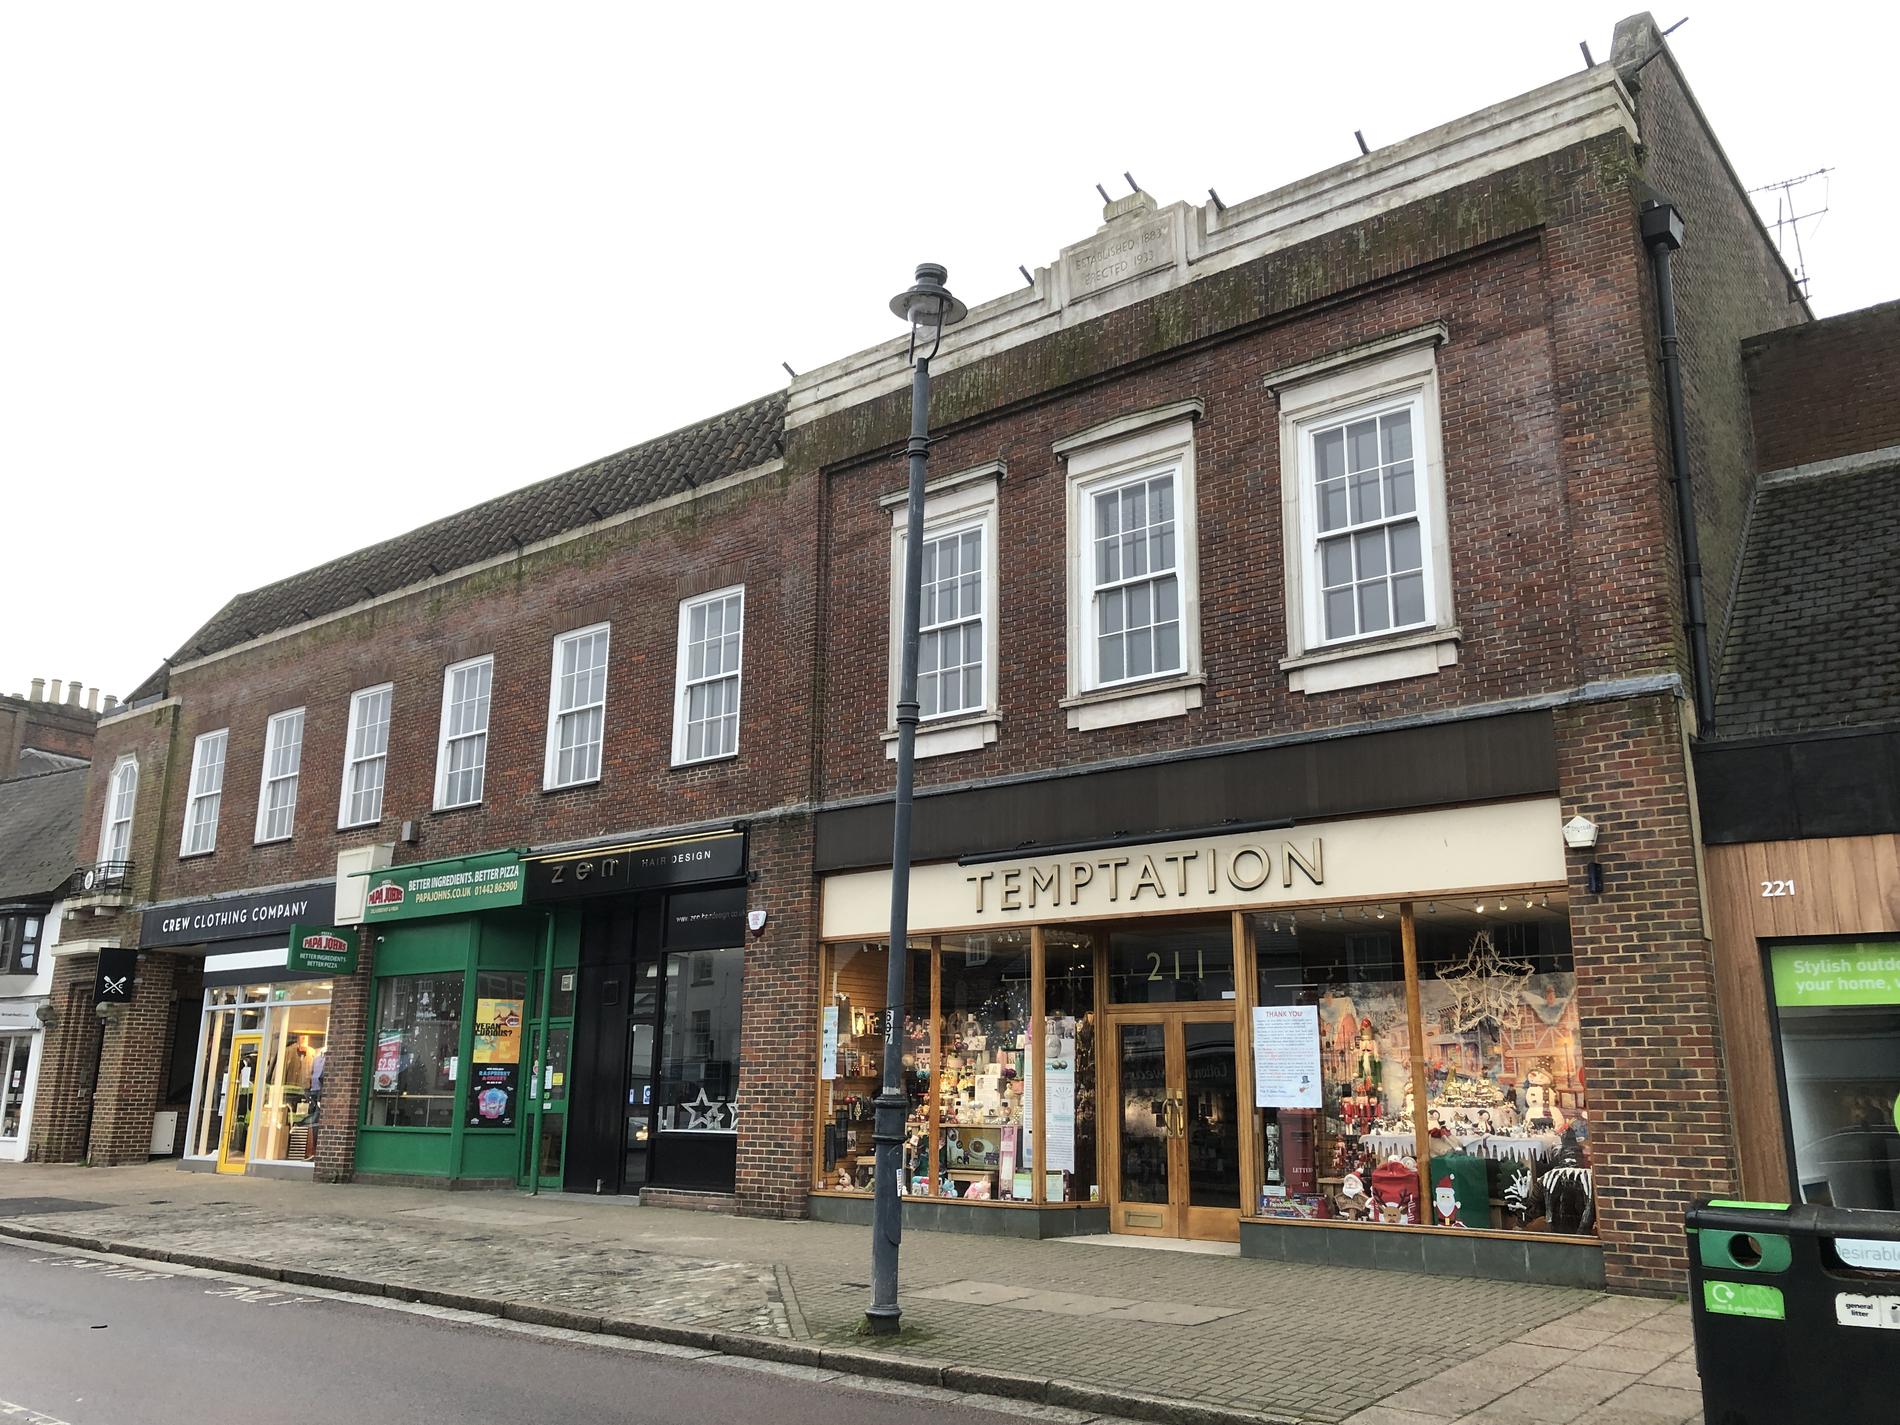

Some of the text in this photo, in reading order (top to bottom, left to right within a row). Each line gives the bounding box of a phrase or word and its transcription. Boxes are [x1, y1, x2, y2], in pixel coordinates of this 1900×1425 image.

[1075, 227, 1162, 271] ESTABLISHED 1883
[1086, 250, 1154, 285] ERECTED 1933
[408, 865, 519, 892] BETTER INGREDIENTS. BETTER PIZZA
[551, 850, 711, 884] zen HAIR DESIGN
[966, 837, 1324, 913] TEMPTATION
[368, 889, 384, 905] PAPA
[415, 880, 518, 904] PAPAJOHNS.CO.UK 01442 862900
[1760, 879, 1795, 897] 221
[162, 900, 308, 933] CREW CLOTHING COMPANY
[304, 937, 347, 952] PAPA JOHNS
[1146, 949, 1204, 982] 211
[1793, 958, 1852, 976] Stylish
[1795, 979, 1834, 995] your
[1838, 976, 1892, 991] home,
[475, 1023, 501, 1031] VEGAN
